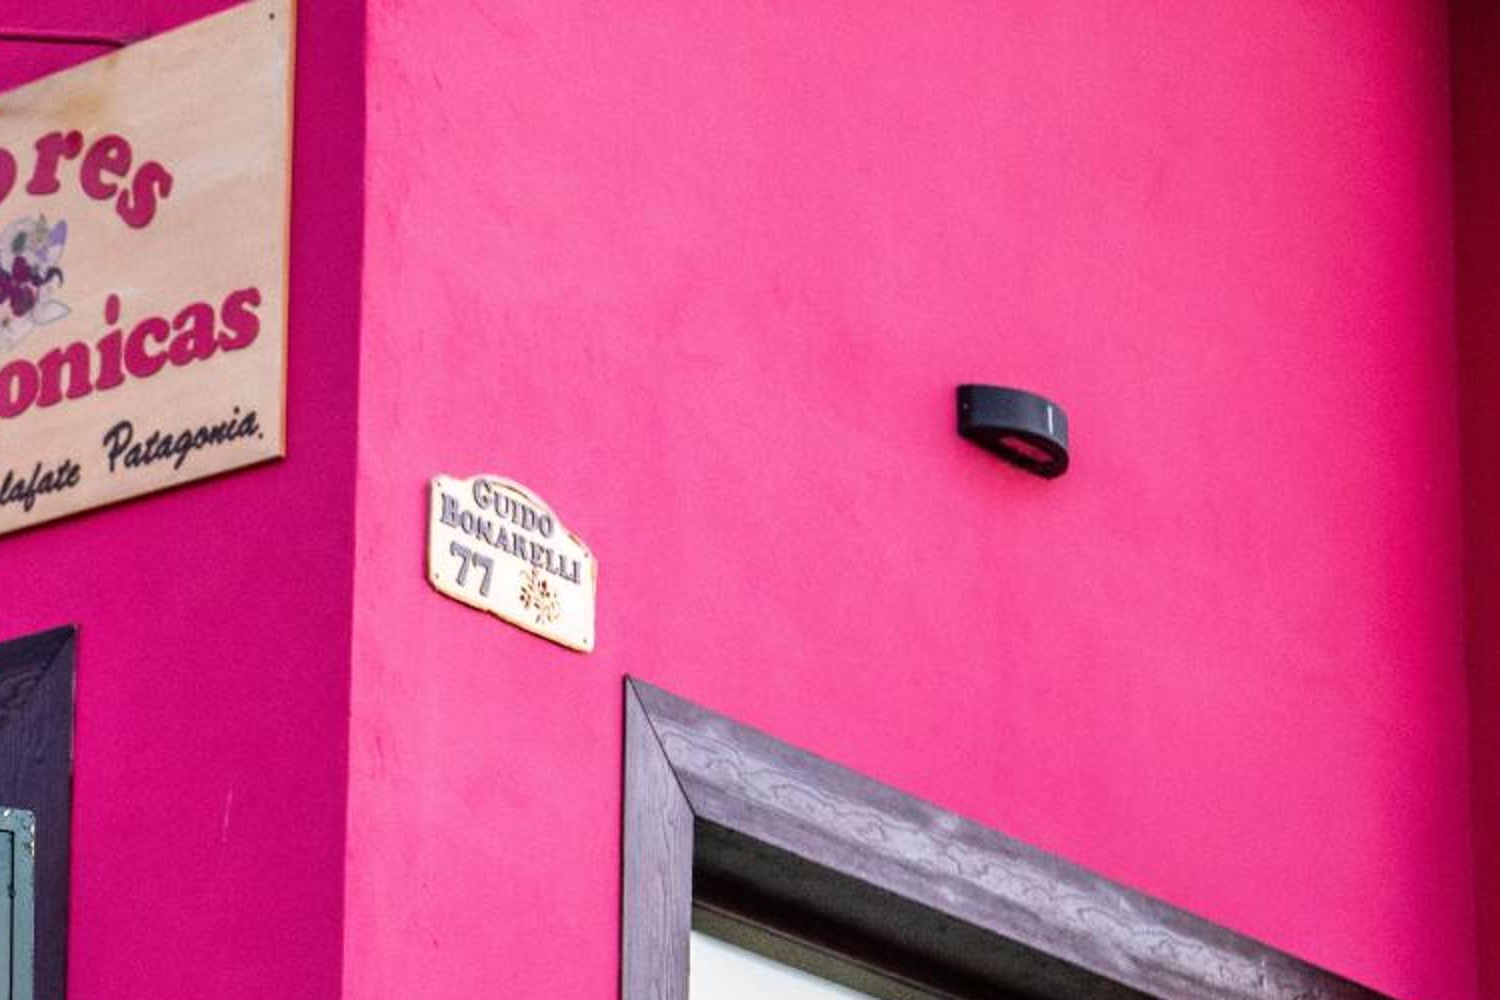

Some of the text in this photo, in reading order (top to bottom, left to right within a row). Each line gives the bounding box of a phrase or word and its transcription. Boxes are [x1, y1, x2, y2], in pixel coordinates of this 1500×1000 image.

[472, 478, 554, 538] GUIDO
[439, 492, 581, 586] BONARELLI
[449, 540, 494, 597] 77
